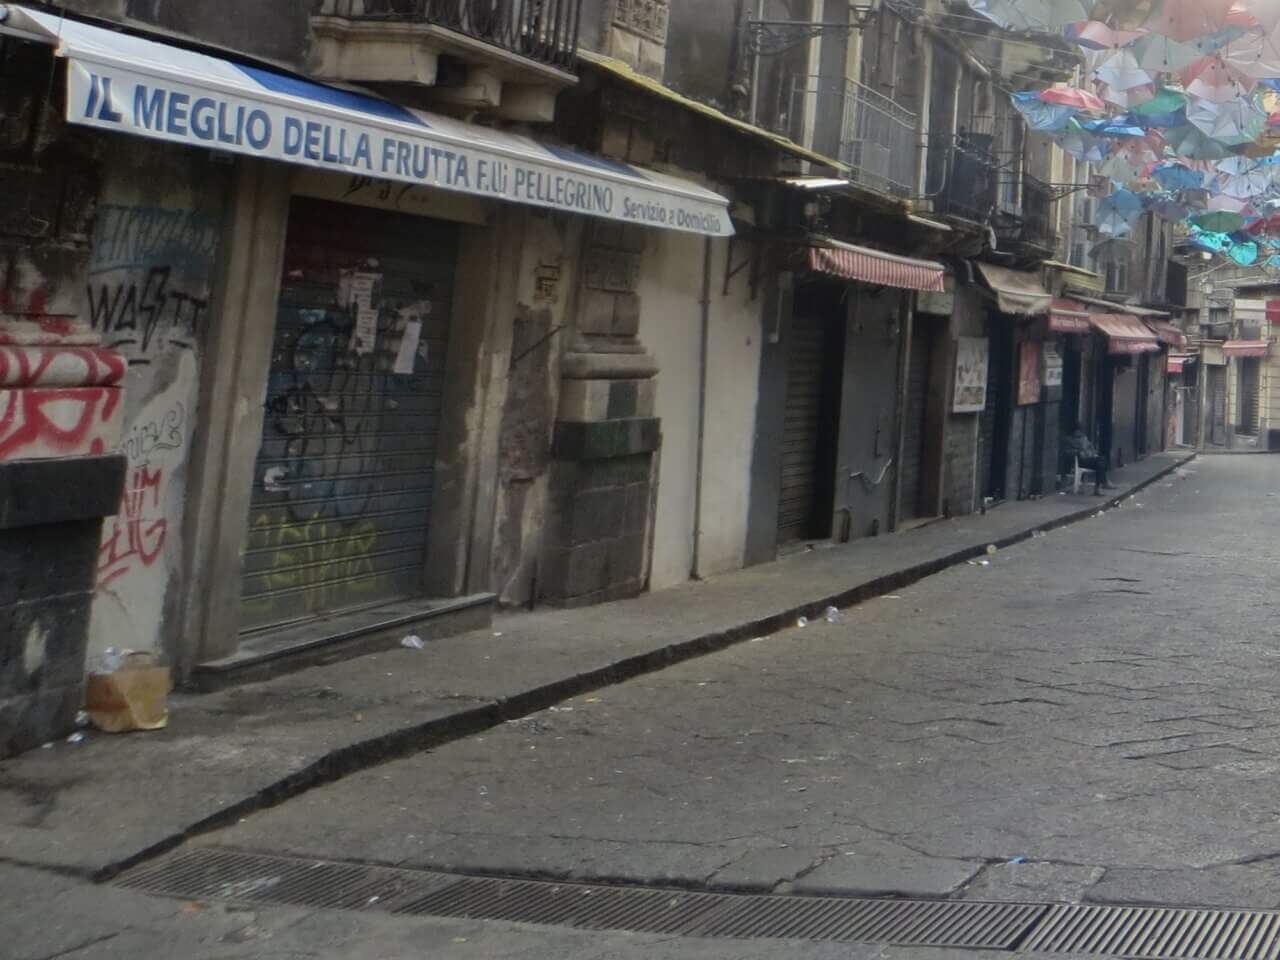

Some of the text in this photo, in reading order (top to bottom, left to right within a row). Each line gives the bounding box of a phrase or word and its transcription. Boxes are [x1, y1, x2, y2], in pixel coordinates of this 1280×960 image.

[84, 73, 123, 124] IL
[133, 83, 273, 151] MEGLIO
[283, 115, 373, 171] DELLA
[381, 137, 471, 189] FRUTTA
[513, 167, 613, 214] PELLEGRINO
[623, 196, 666, 223] Servizio
[678, 207, 721, 233] Domicilio
